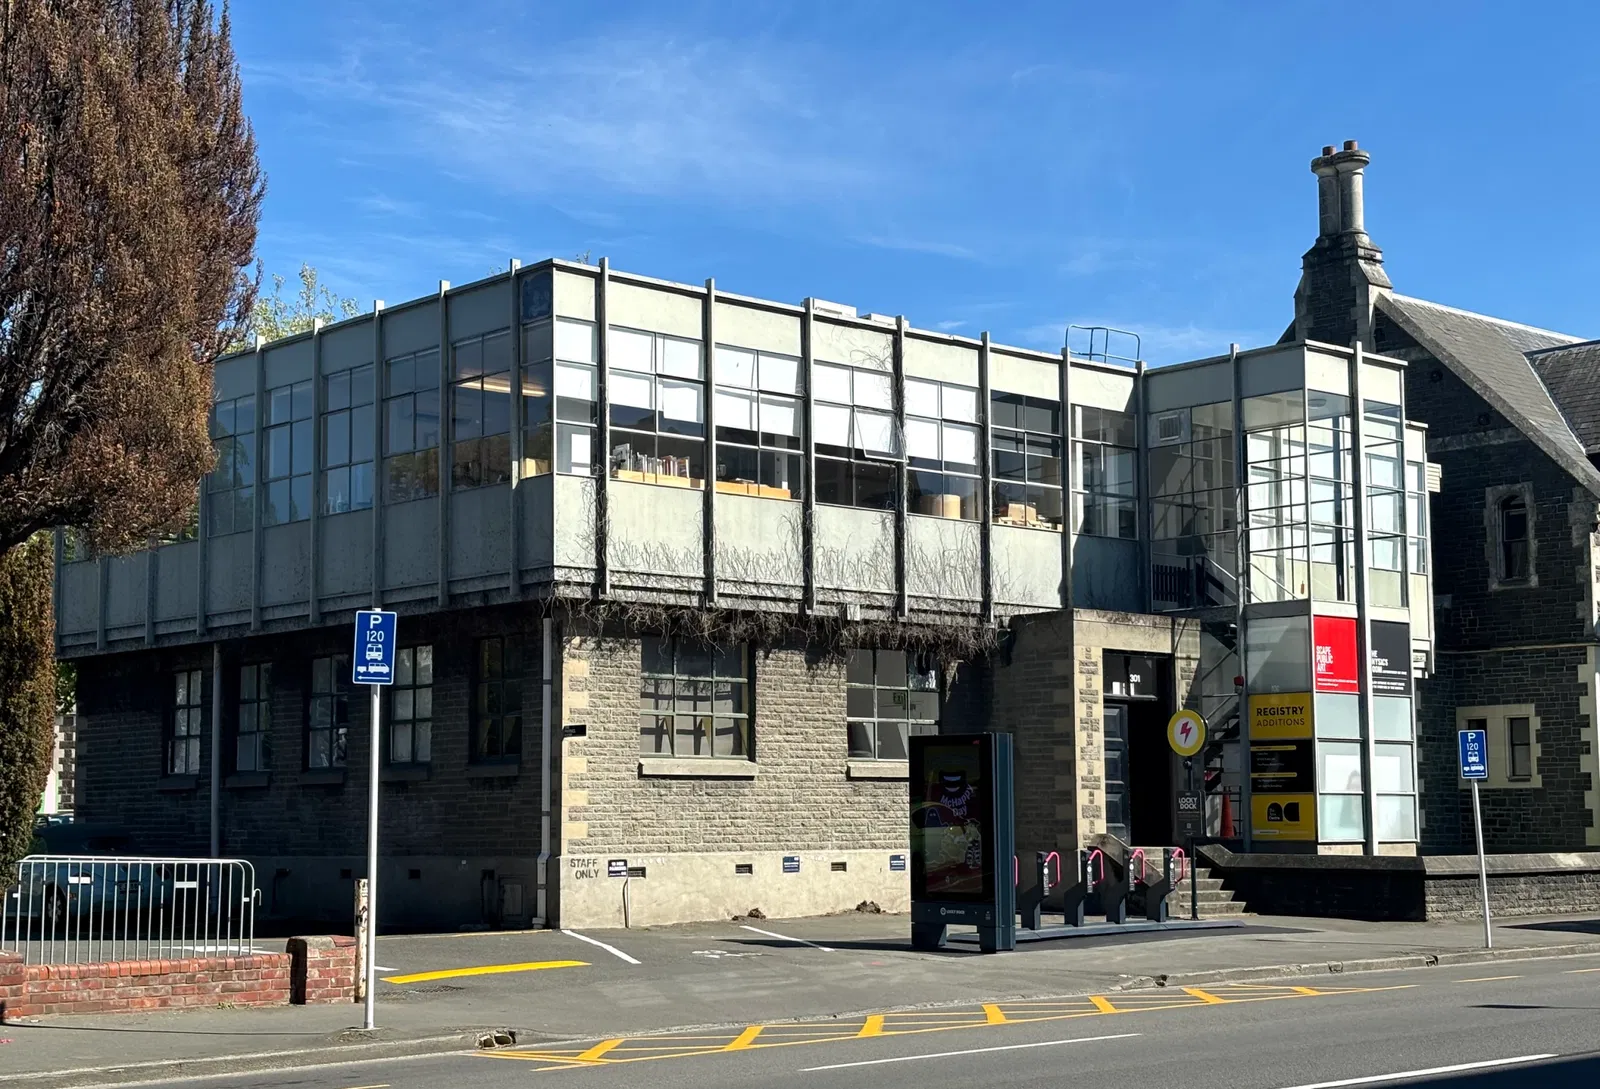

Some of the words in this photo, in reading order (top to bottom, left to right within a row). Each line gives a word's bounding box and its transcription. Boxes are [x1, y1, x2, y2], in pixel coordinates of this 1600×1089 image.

[370, 615, 382, 629] P
[366, 630, 385, 642] 120
[1316, 645, 1331, 655] SCAPE
[1316, 654, 1333, 664] PUBLIC
[1130, 674, 1141, 682] 301
[1256, 705, 1304, 716] REGISTRY
[1256, 717, 1305, 727] ADDITIONS
[1468, 732, 1476, 742] P
[940, 784, 975, 808] McHappy
[952, 805, 968, 817] Day
[570, 858, 597, 867] STAFF
[575, 869, 599, 879] ONLY
